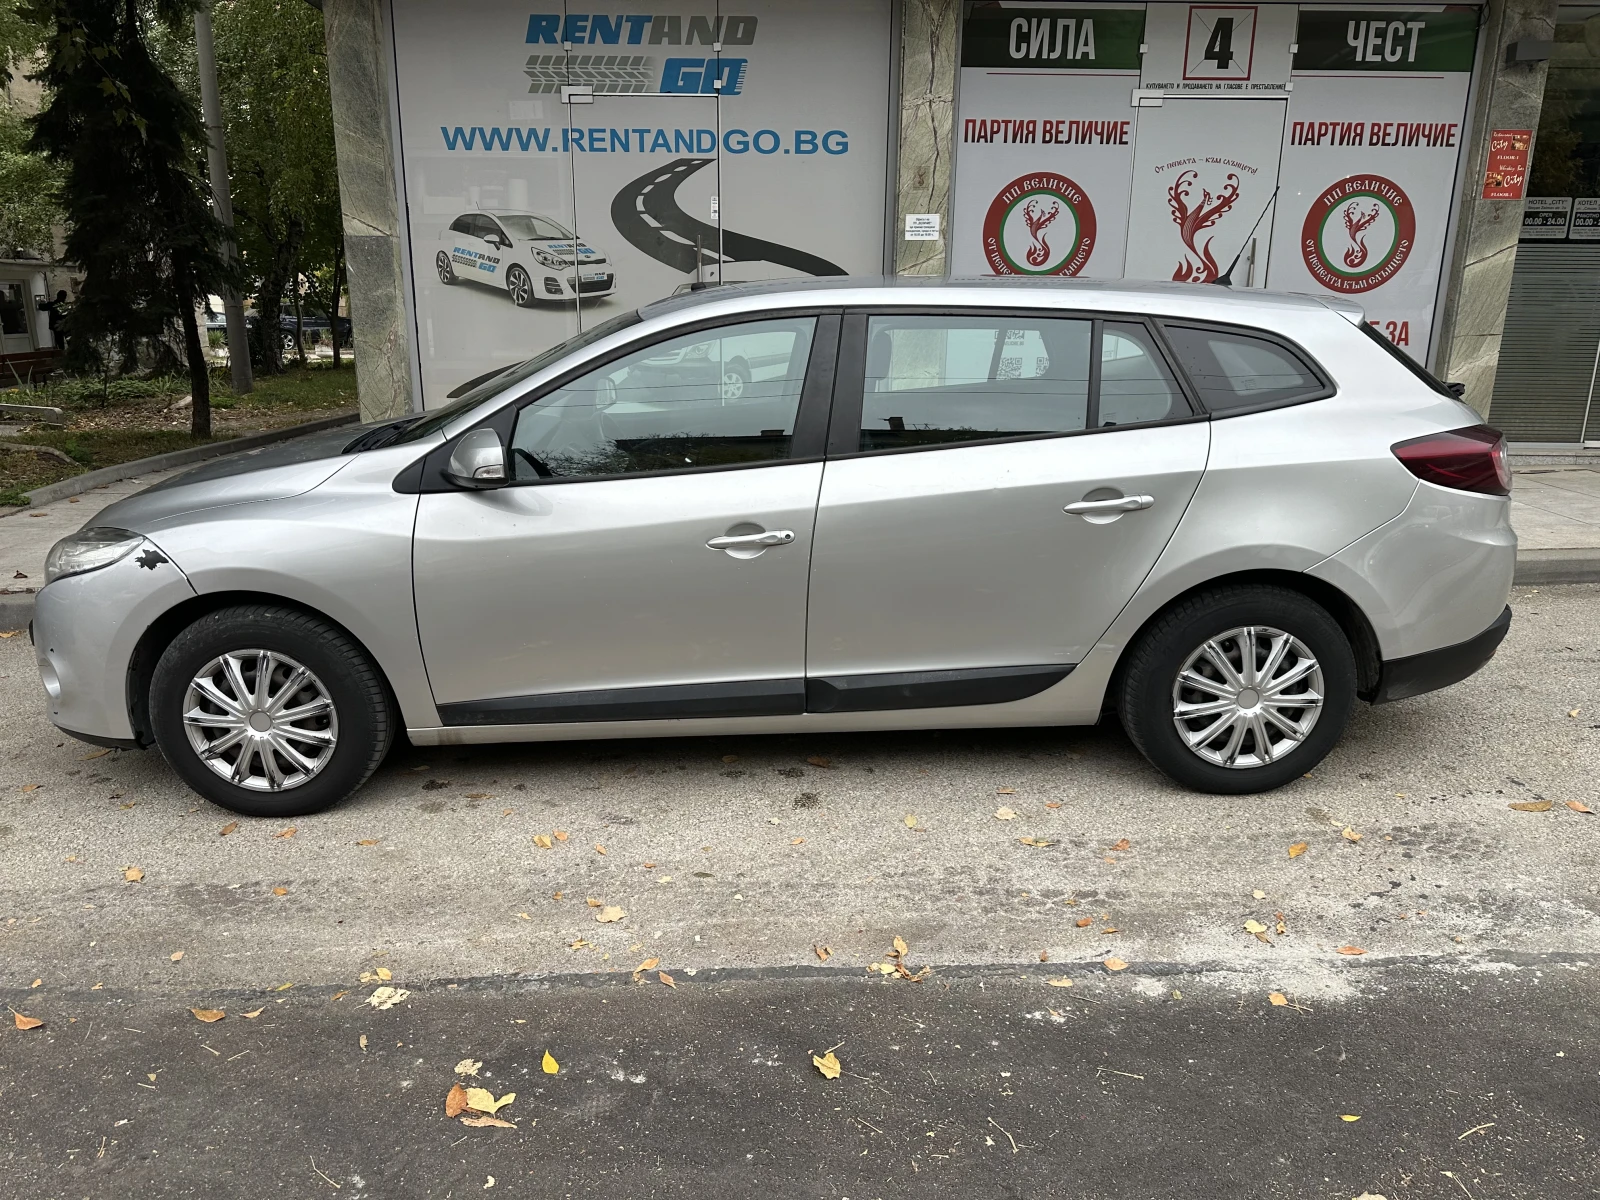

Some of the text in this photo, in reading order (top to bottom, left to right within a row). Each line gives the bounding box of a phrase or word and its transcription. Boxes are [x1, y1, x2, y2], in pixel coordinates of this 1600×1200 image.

[1009, 17, 1096, 60] СИЛА
[1204, 17, 1234, 69] 4
[1347, 20, 1426, 62] ЧЕСТ
[660, 58, 748, 95] GO
[1146, 82, 1174, 90] КУПУВАНЕТО
[441, 126, 849, 155] WWW.RENTANDGO.BG
[964, 118, 1131, 145] ПАРТИЯ ВЕЛИЧИЕ
[1290, 121, 1458, 147] ПАРТИЯ ВЕЛИЧИЕ
[1491, 139, 1508, 151] City
[1002, 178, 1082, 204] ПП ВЕЛИЧИЕ
[1323, 180, 1403, 206] ПП ВЕЛИЧИЕ
[1504, 174, 1523, 187] City
[453, 246, 500, 264] RENTAND
[988, 237, 997, 251] ОТ
[478, 261, 497, 273] GO
[1306, 239, 1409, 289] ОТ ПЕПЕЛТА КЪМ СЛЪНЦЕТО
